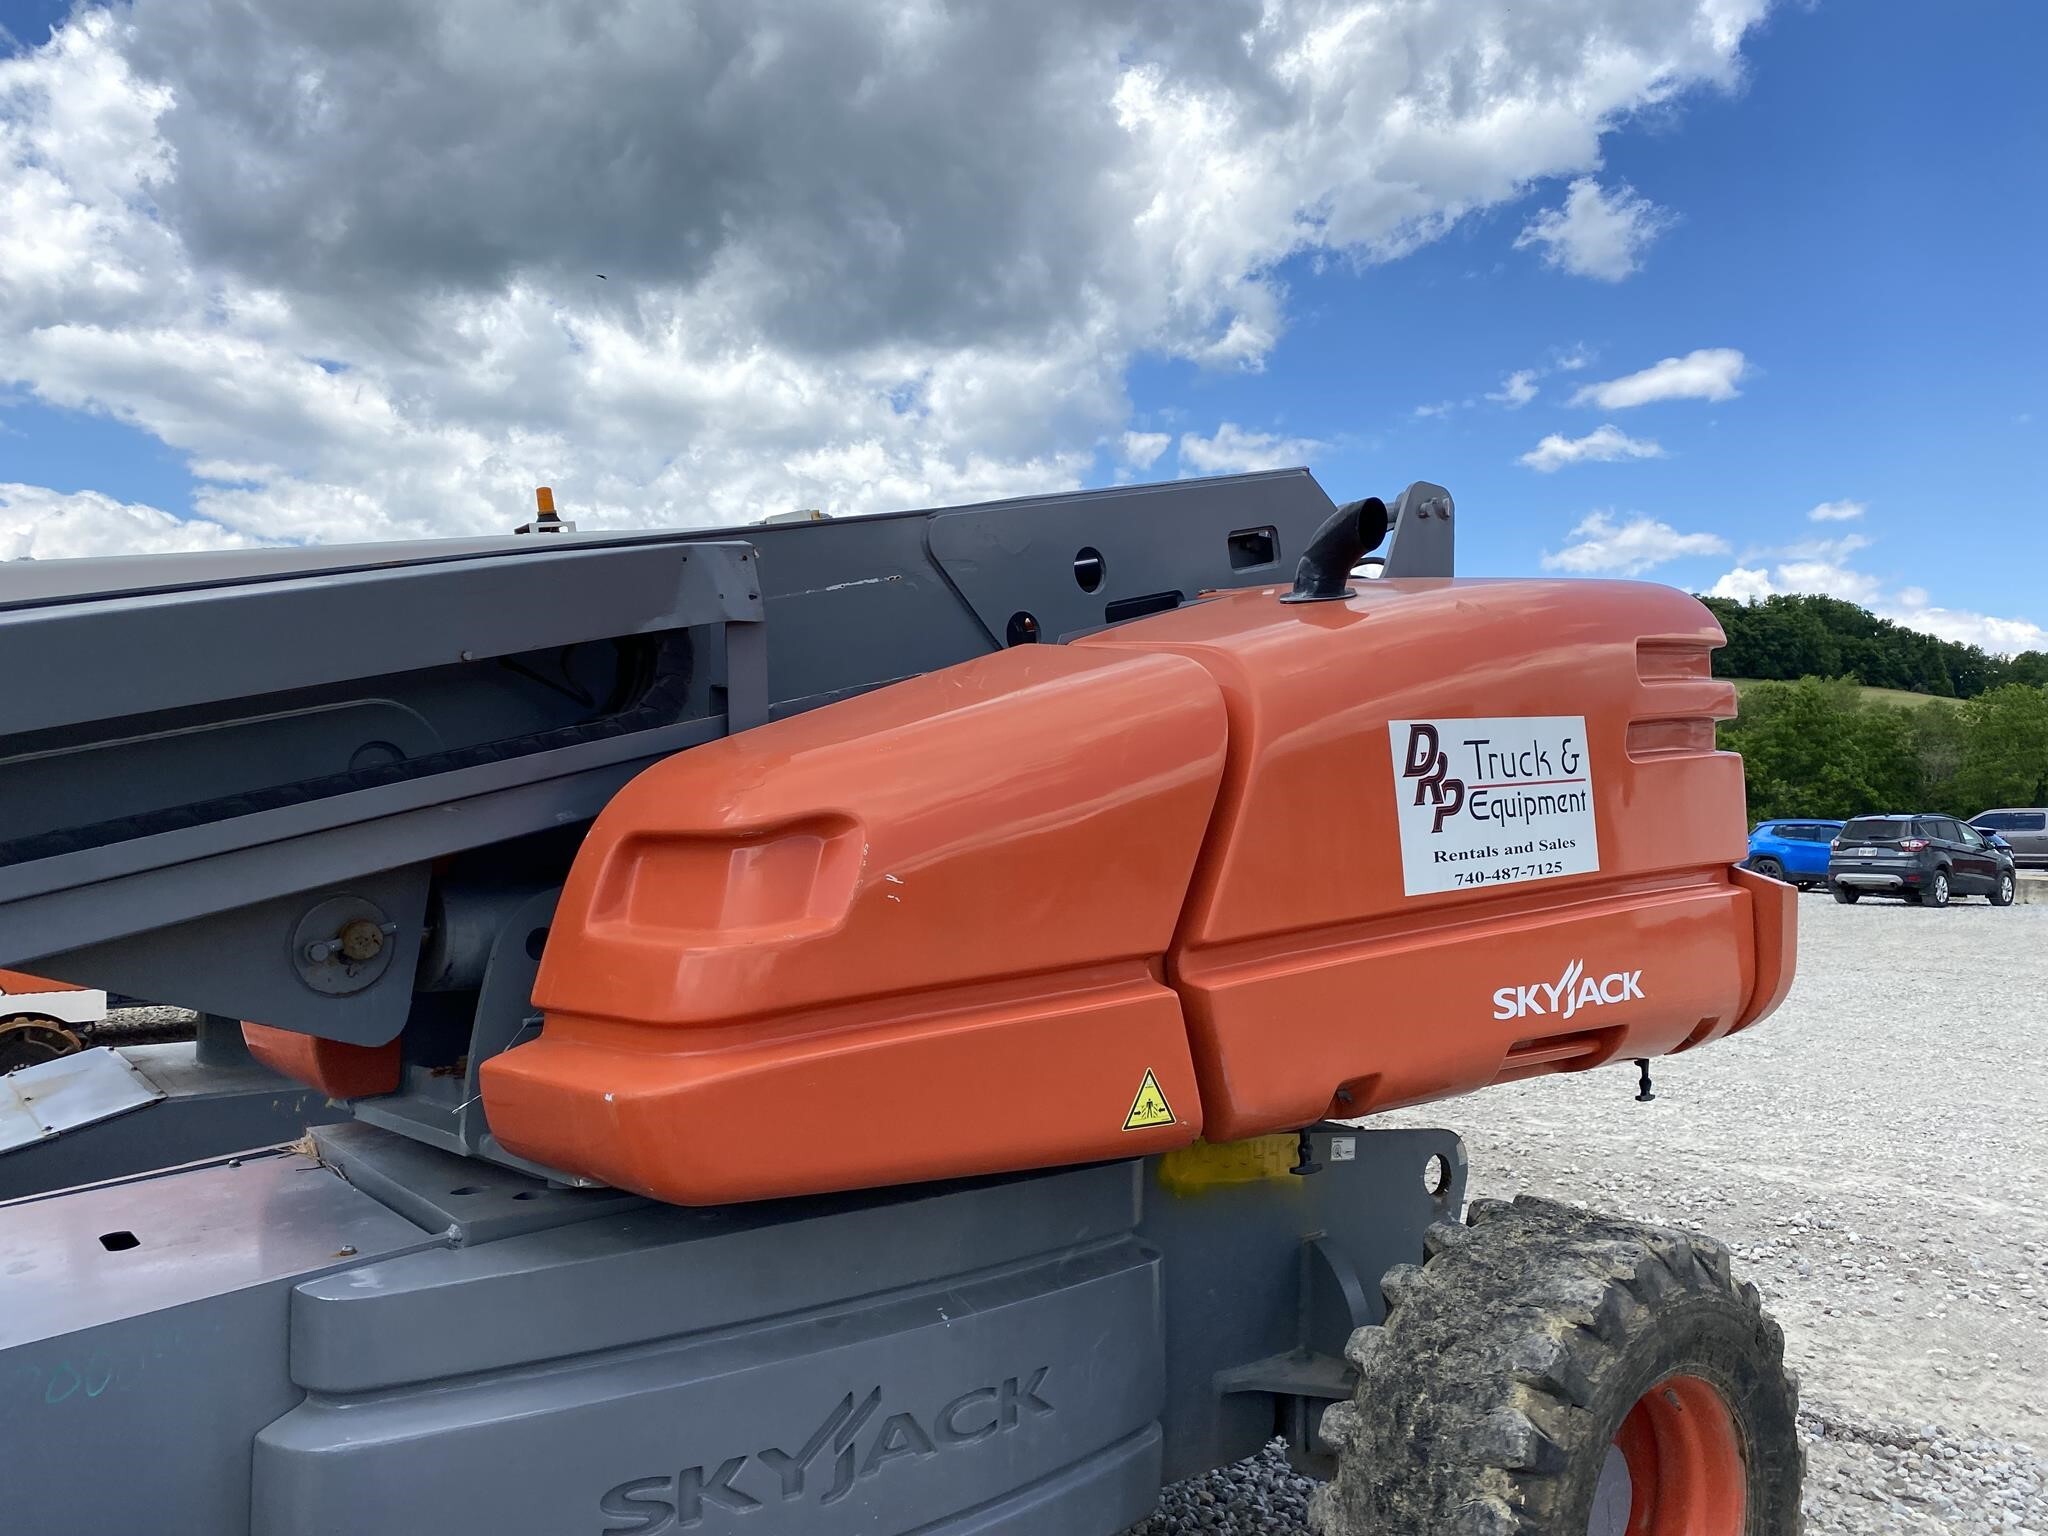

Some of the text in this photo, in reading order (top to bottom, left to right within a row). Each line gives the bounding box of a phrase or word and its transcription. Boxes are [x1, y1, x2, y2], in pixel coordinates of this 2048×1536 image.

[1402, 723, 1465, 833] DRP
[1463, 738, 1580, 779] Truck &
[1469, 789, 1586, 827] Equipment
[1434, 838, 1576, 863] Rentals and Sales
[1454, 861, 1563, 886] 740-487-7125
[1493, 958, 1645, 1020] SKYJACK
[600, 1366, 1056, 1536] SKYJACK
